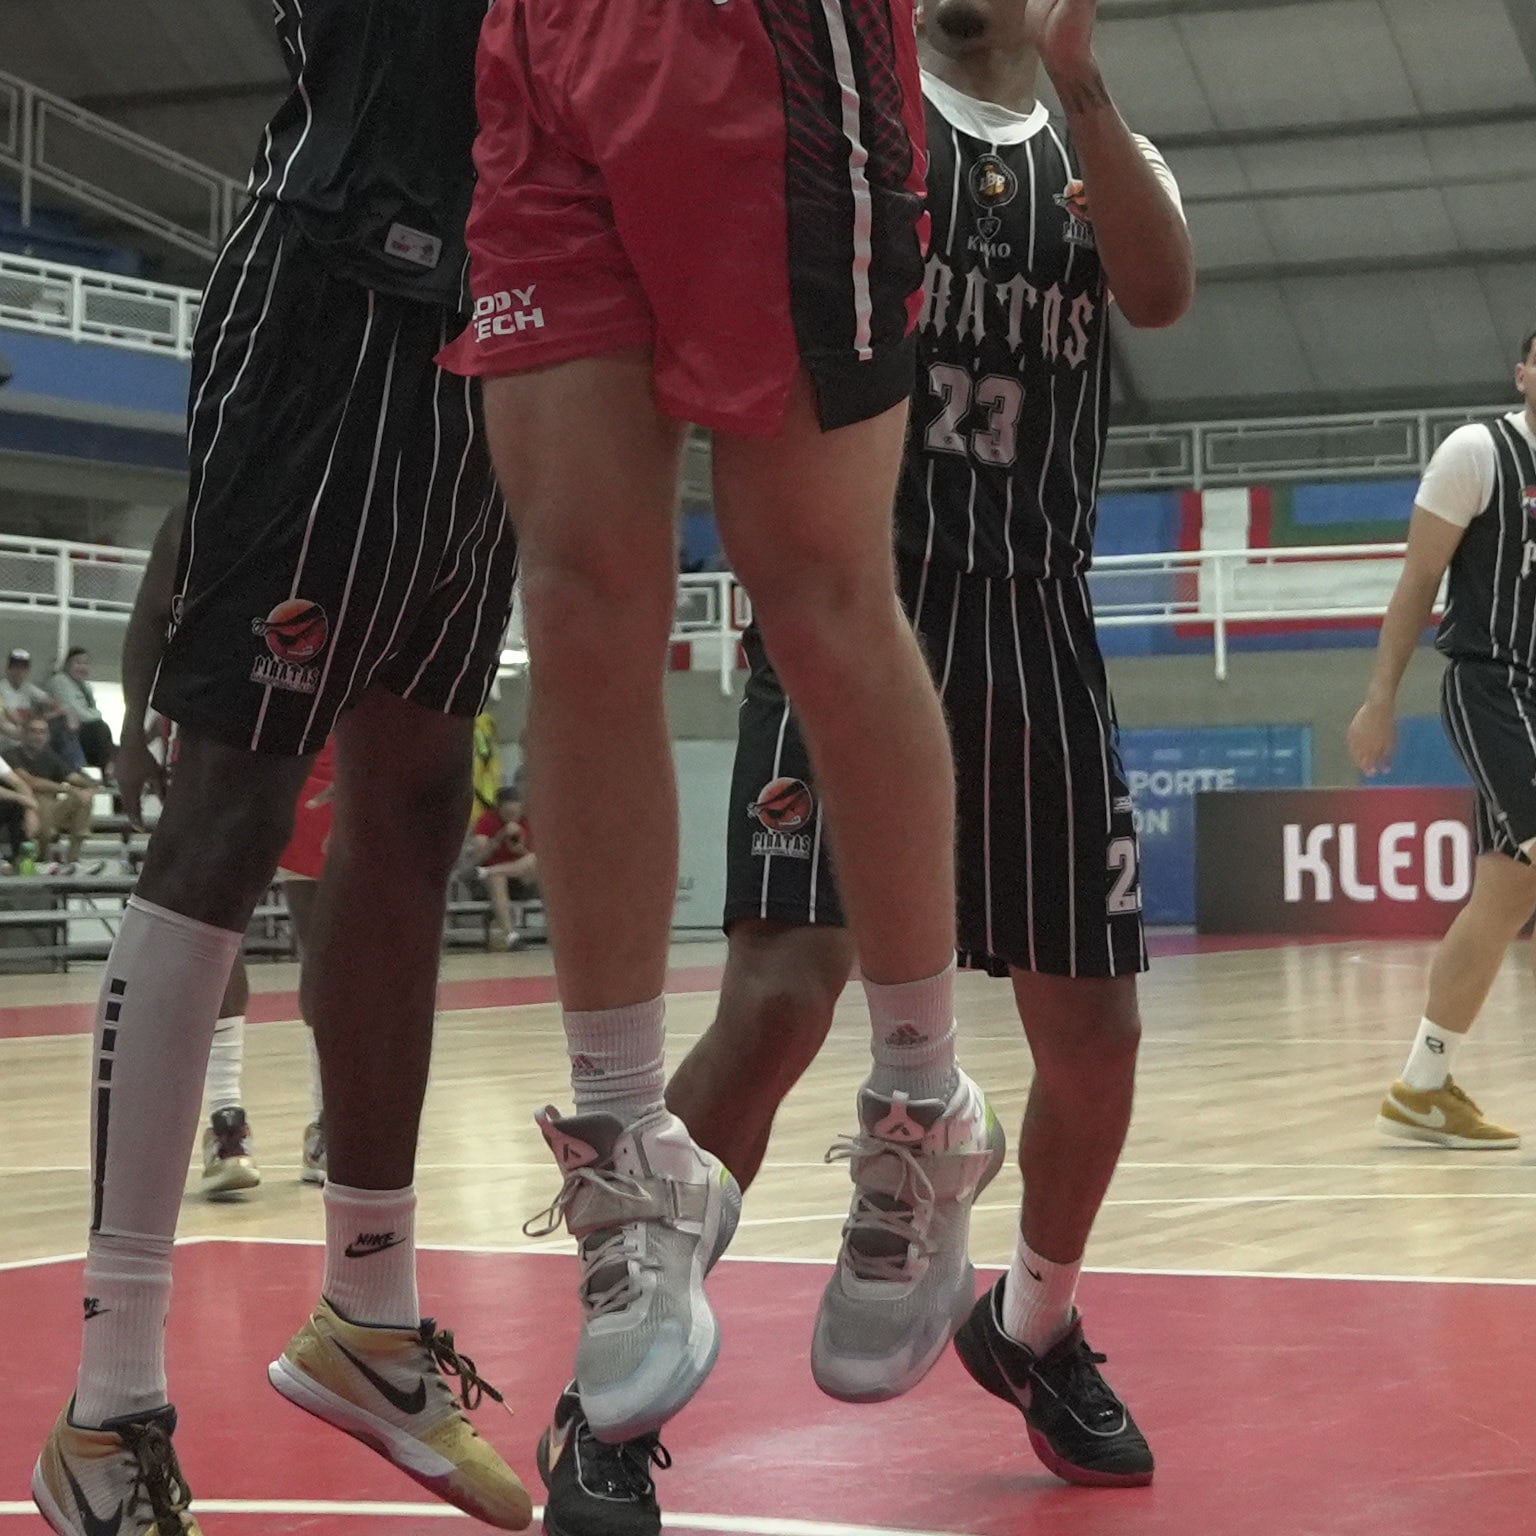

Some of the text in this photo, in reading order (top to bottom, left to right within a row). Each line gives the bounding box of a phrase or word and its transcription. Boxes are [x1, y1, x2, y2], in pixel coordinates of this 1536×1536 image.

[924, 361, 1026, 468] 23
[751, 831, 812, 851] PIRATAS
[1283, 819, 1471, 902] KLEO
[356, 1231, 396, 1246] NIKE
